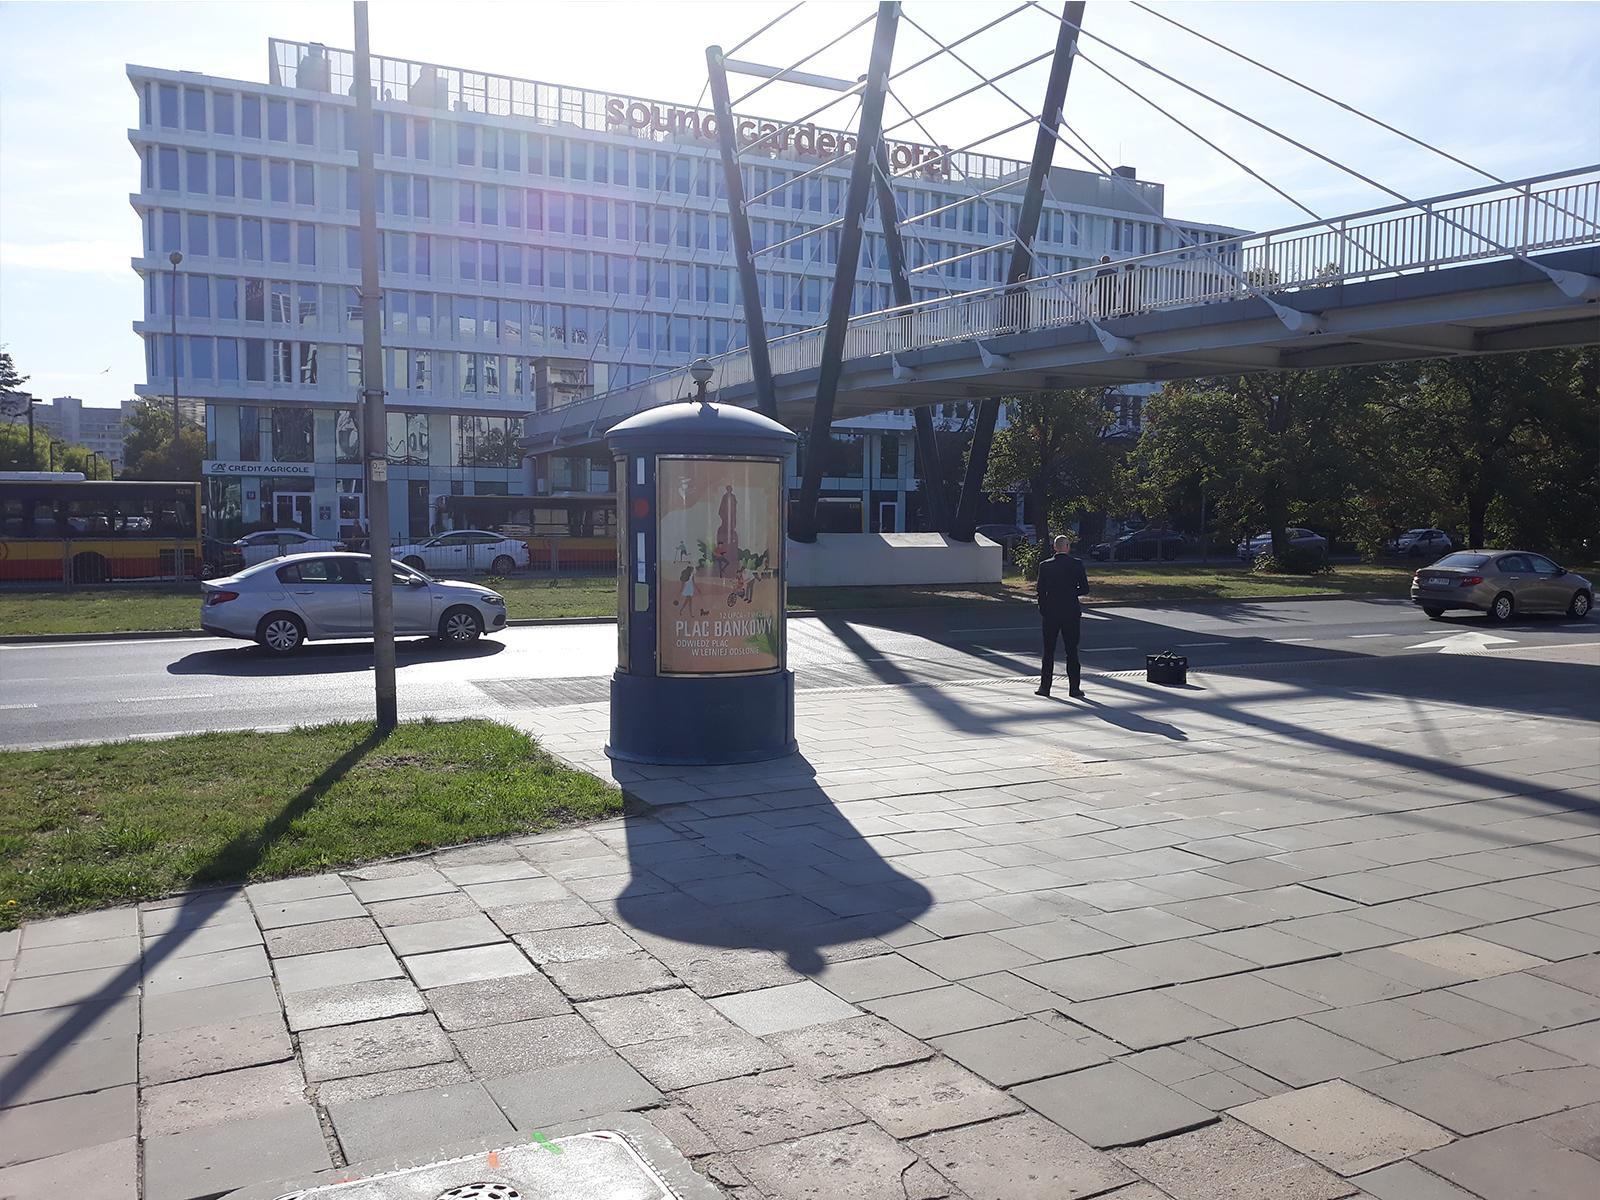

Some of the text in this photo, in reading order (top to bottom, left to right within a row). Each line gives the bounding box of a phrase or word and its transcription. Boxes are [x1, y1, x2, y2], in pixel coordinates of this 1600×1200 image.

[264, 465, 309, 473] AGRICOLE
[676, 618, 772, 637] PLAC BANKOWY
[712, 639, 729, 648] PLAC
[692, 648, 699, 656] W
[700, 648, 727, 656] LETNIEJ
